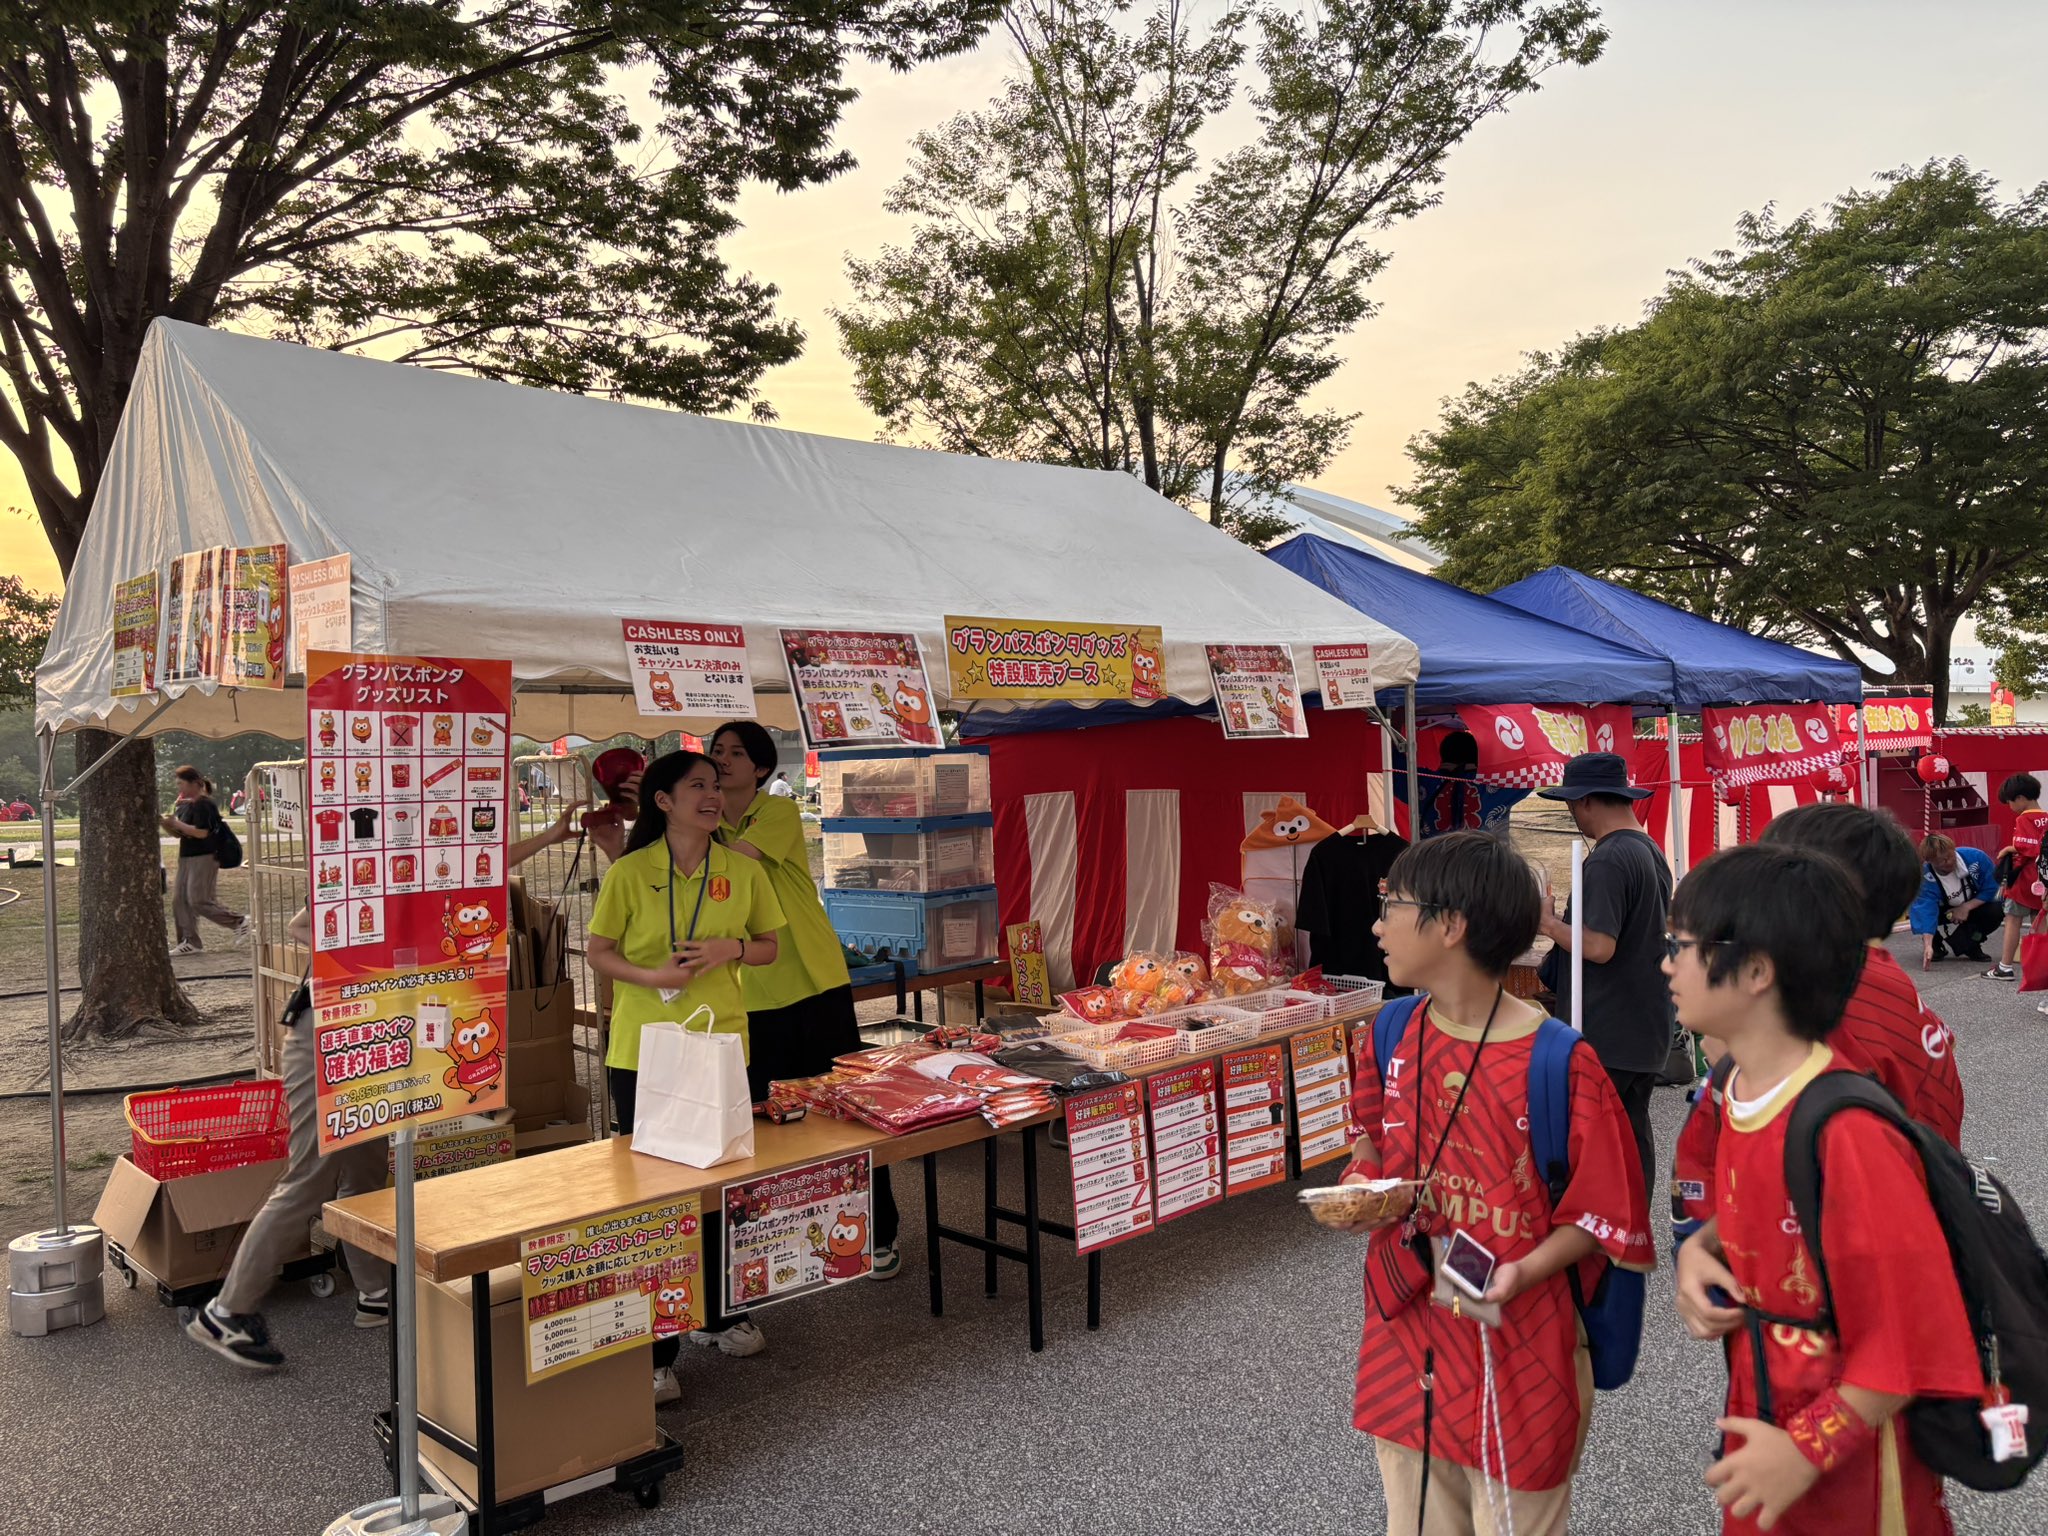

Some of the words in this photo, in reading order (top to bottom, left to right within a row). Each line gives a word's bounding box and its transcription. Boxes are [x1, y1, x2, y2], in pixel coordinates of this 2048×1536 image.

[292, 570, 327, 587] CASHLESS
[328, 563, 348, 580] ONLY
[627, 626, 701, 641] CASHLESS
[704, 630, 740, 644] ONLY
[807, 635, 898, 649] グランパスポンタグッズ
[951, 626, 1127, 657] グランパスポンタグッズ
[634, 645, 680, 656] お支払いは
[1315, 649, 1349, 659] CASHLESS
[1350, 647, 1367, 657] ONLY
[638, 656, 741, 671] キャッシュレス決済のみ
[798, 668, 889, 679] グランパスポンタグッズ購入で
[987, 658, 1100, 686] 特設販売ブース
[342, 664, 464, 684] グランパスポンタ
[704, 673, 744, 684] となります
[802, 679, 864, 690] 勝ち点さんステッカー
[356, 686, 449, 704] グッズリスト
[819, 690, 856, 700] プレゼント！
[341, 967, 475, 999] 選手のサインが必ずもらえる！
[321, 1003, 369, 1022] 数量限定！
[321, 1017, 415, 1052] 選手直筆サイン
[325, 1039, 411, 1082] 確約福袋
[467, 1063, 497, 1080] GRAMPUS
[1152, 1068, 1198, 1088] グランパスポンタグッズ
[335, 1075, 431, 1106] 最大9,850円相当が入って
[1157, 1079, 1194, 1098] 好評販売中！
[1069, 1090, 1123, 1110] グランパスポンタグッズ
[1075, 1101, 1118, 1121] 好評販売中！
[752, 1163, 849, 1199] グランパスポンタグッズ
[1420, 1163, 1484, 1197] NAGOYA
[769, 1182, 831, 1208] 特設販売ブース
[586, 1203, 692, 1238] 推しが出るまで欲しくなる！？
[733, 1203, 830, 1239] グランパスポンタグッズ購入で
[1419, 1187, 1533, 1240] AMPUS
[680, 1219, 697, 1232] 全7種
[527, 1220, 678, 1275] ランダムポストカード
[528, 1232, 572, 1251] 数量限定！
[735, 1226, 801, 1249] 勝ち点さんステッカー
[750, 1241, 787, 1258] プレゼント！
[541, 1241, 683, 1289] グッズ購入金額に応じてプレゼント！
[544, 1315, 578, 1331] 4,000円以上
[614, 1300, 624, 1308] 1枚
[544, 1325, 578, 1341] 6,000円以上
[614, 1310, 625, 1319] 2枚
[545, 1337, 579, 1353] 9,000円以上
[615, 1321, 625, 1330] 5枚
[544, 1348, 581, 1366] 15,000円以上
